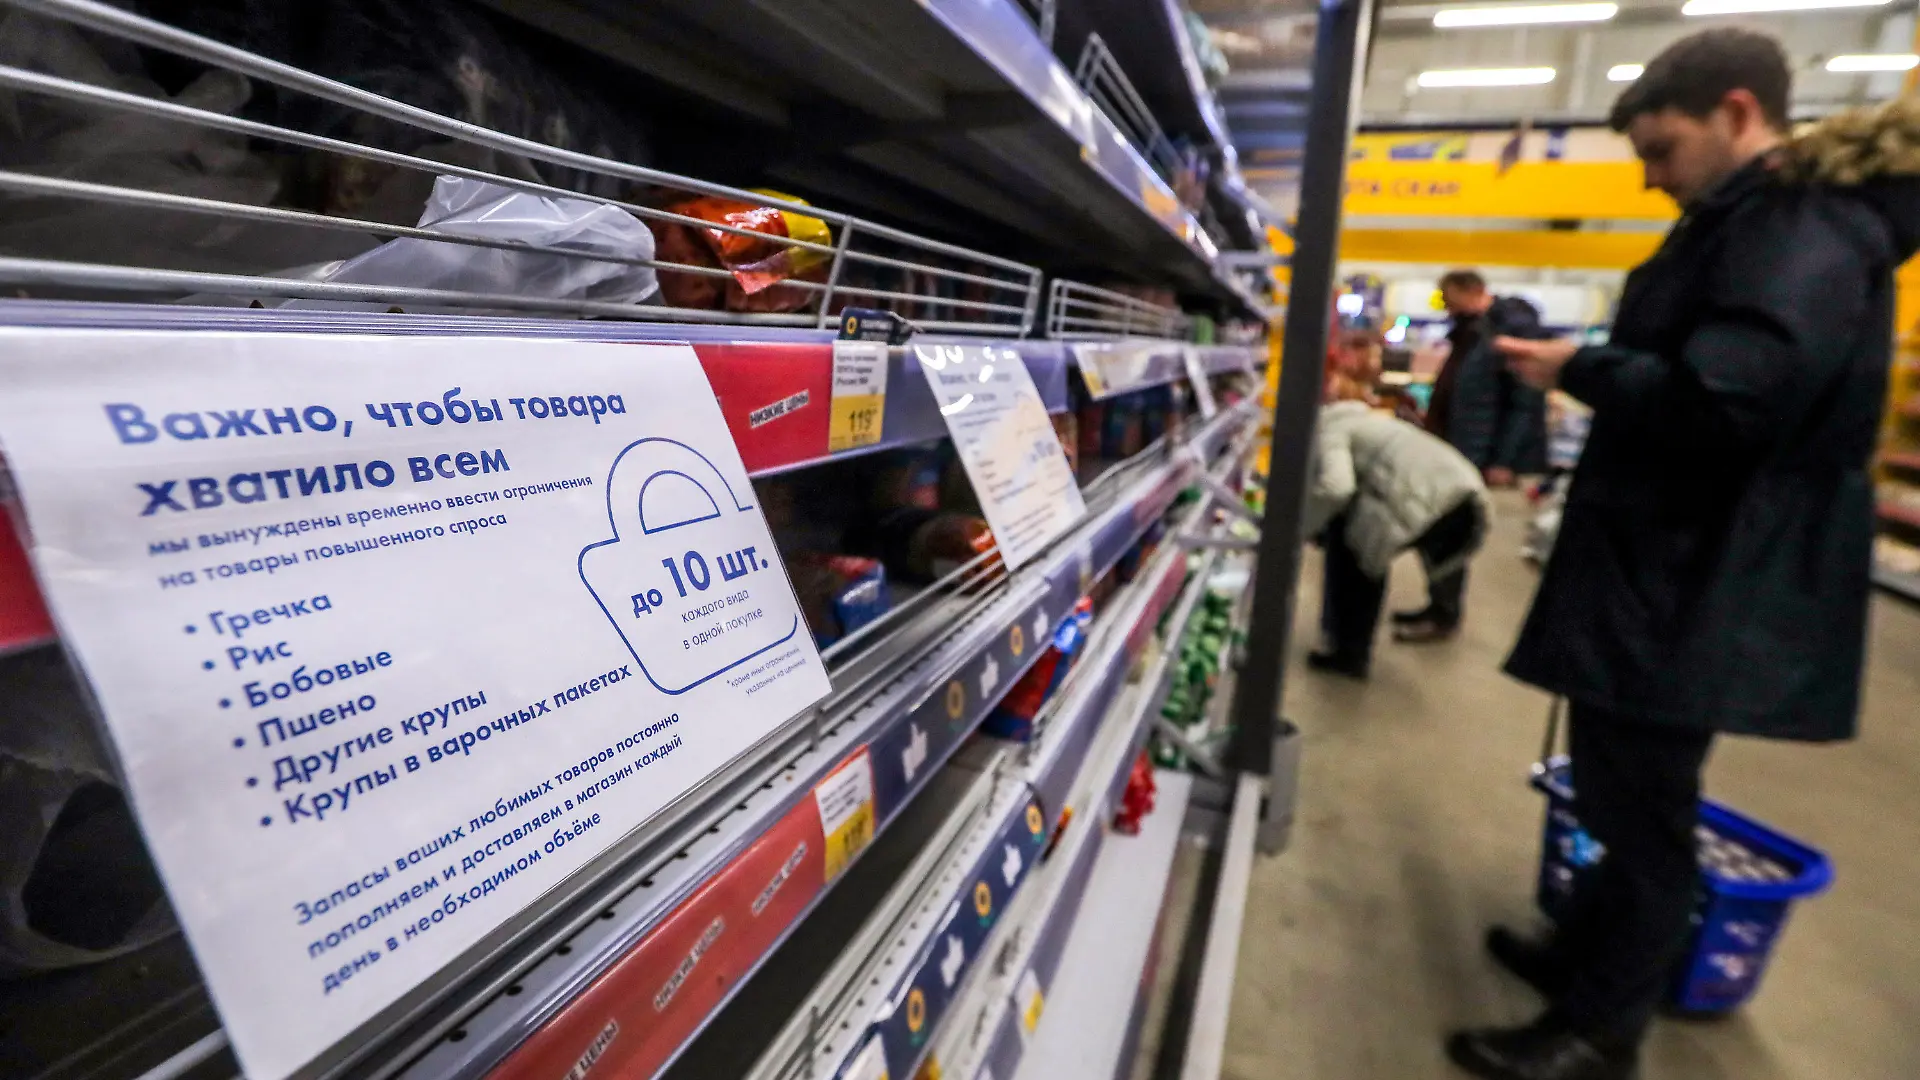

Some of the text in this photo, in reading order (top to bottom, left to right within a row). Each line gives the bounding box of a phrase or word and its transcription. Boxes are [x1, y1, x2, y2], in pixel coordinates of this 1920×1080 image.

[104, 386, 627, 446] Важно, чтобы товара
[750, 401, 784, 426] НИЗКИЕ
[136, 448, 511, 518] хватило всем
[146, 476, 593, 558] мы вынуждены временно ввести ограничения
[156, 514, 508, 591] на товары повышенного спроса
[630, 545, 769, 619] до 10 шт.
[207, 593, 334, 640] Гречка
[681, 589, 750, 624] каждого вида
[682, 608, 763, 650] в одной покупке
[225, 640, 294, 672] Рис
[243, 651, 393, 709] Бобовые
[257, 694, 377, 747] Пшено
[273, 690, 487, 792] Другие крупы
[283, 664, 633, 824] Крупы в варочных пакетах
[293, 713, 679, 926] Запасы ваших любимых товаров постоянно
[307, 733, 683, 959] пополняем и доставляем в магазин каждый
[322, 812, 601, 996] день в необходимом объёме
[579, 1022, 617, 1072] ЦЕНЫ
